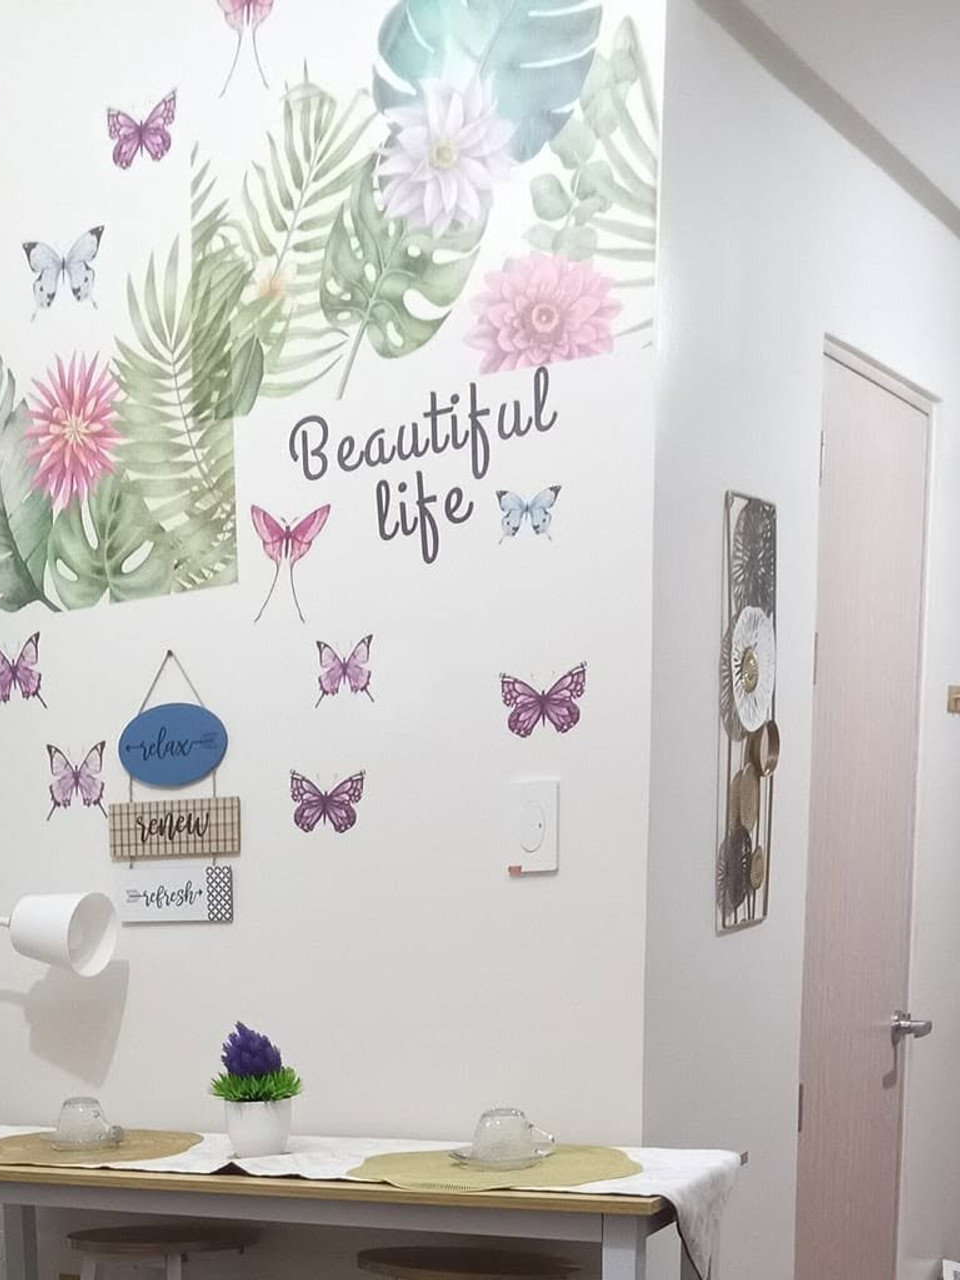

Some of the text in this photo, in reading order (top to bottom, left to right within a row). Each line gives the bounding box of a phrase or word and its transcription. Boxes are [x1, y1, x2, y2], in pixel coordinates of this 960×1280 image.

[288, 366, 558, 481] Beautiful
[375, 470, 474, 564] life
[138, 726, 193, 762] relax
[135, 812, 210, 843] renew
[141, 880, 198, 908] refresh
